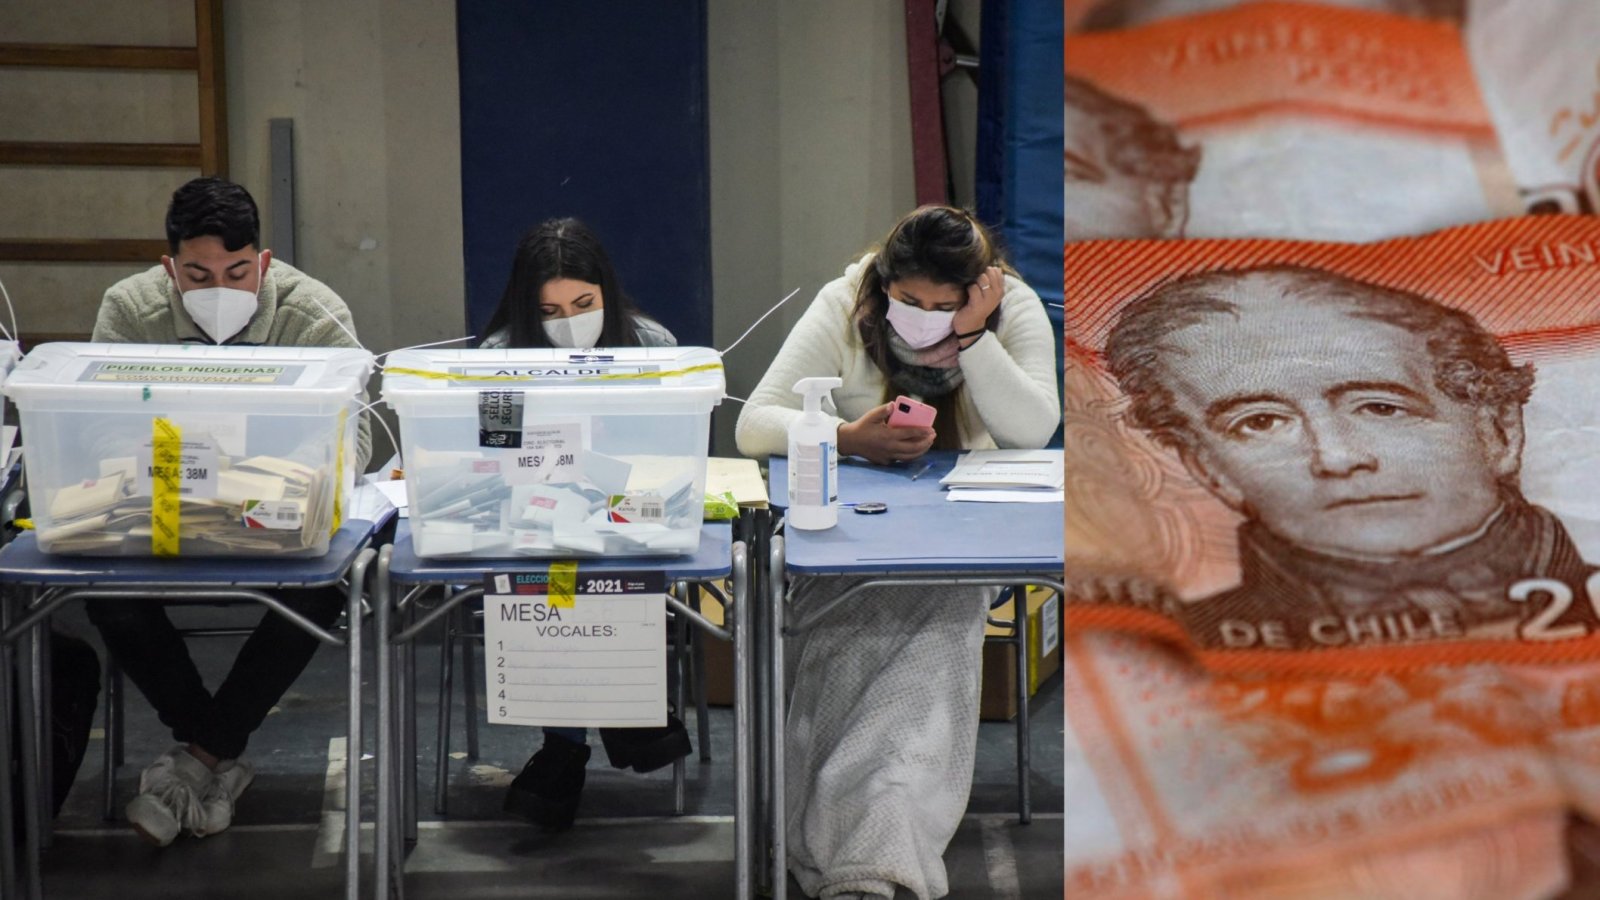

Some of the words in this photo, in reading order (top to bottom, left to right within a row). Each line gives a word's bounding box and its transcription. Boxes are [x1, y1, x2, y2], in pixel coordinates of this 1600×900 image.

[105, 364, 185, 373] PUEBLOS
[188, 366, 277, 374] INDÍGENAS
[494, 368, 610, 376] ALCALDE
[488, 391, 500, 420] SELLO
[185, 467, 208, 480] 38M
[586, 579, 624, 593] 2021
[501, 602, 562, 622] MESA
[536, 625, 617, 638] VOCALES:
[1219, 618, 1291, 648] DE
[1307, 609, 1465, 646] CHILE
[496, 640, 503, 652] 1
[496, 655, 505, 668] 2
[497, 672, 506, 685] 3
[497, 689, 506, 701] 4
[498, 705, 507, 718] 5
